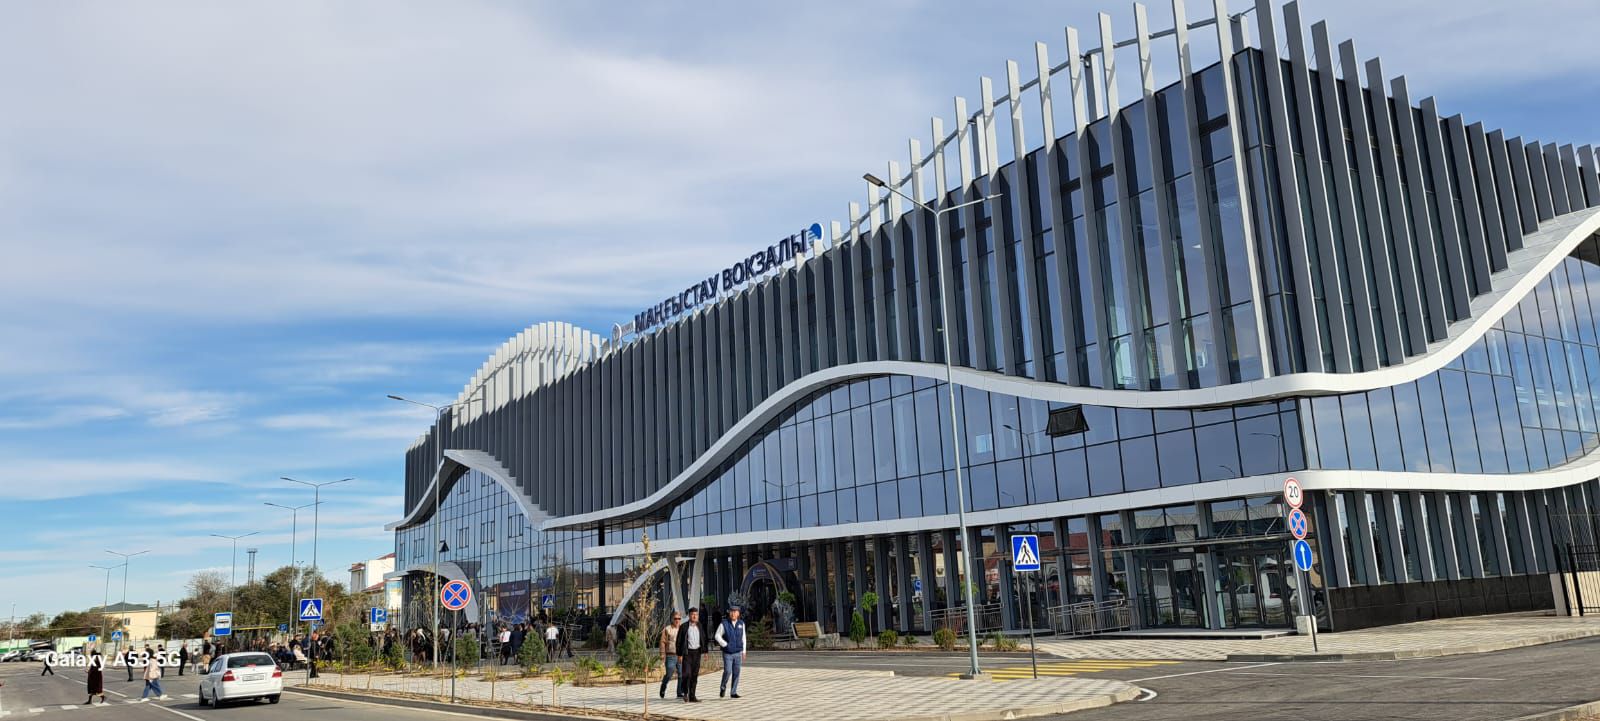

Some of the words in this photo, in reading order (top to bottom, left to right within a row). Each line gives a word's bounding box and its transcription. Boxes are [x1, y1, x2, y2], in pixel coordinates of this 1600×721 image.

[634, 273, 720, 333] МАҢҒЫСТАУ
[722, 229, 806, 291] ВОКЗАЛЫ
[1288, 486, 1299, 498] 20
